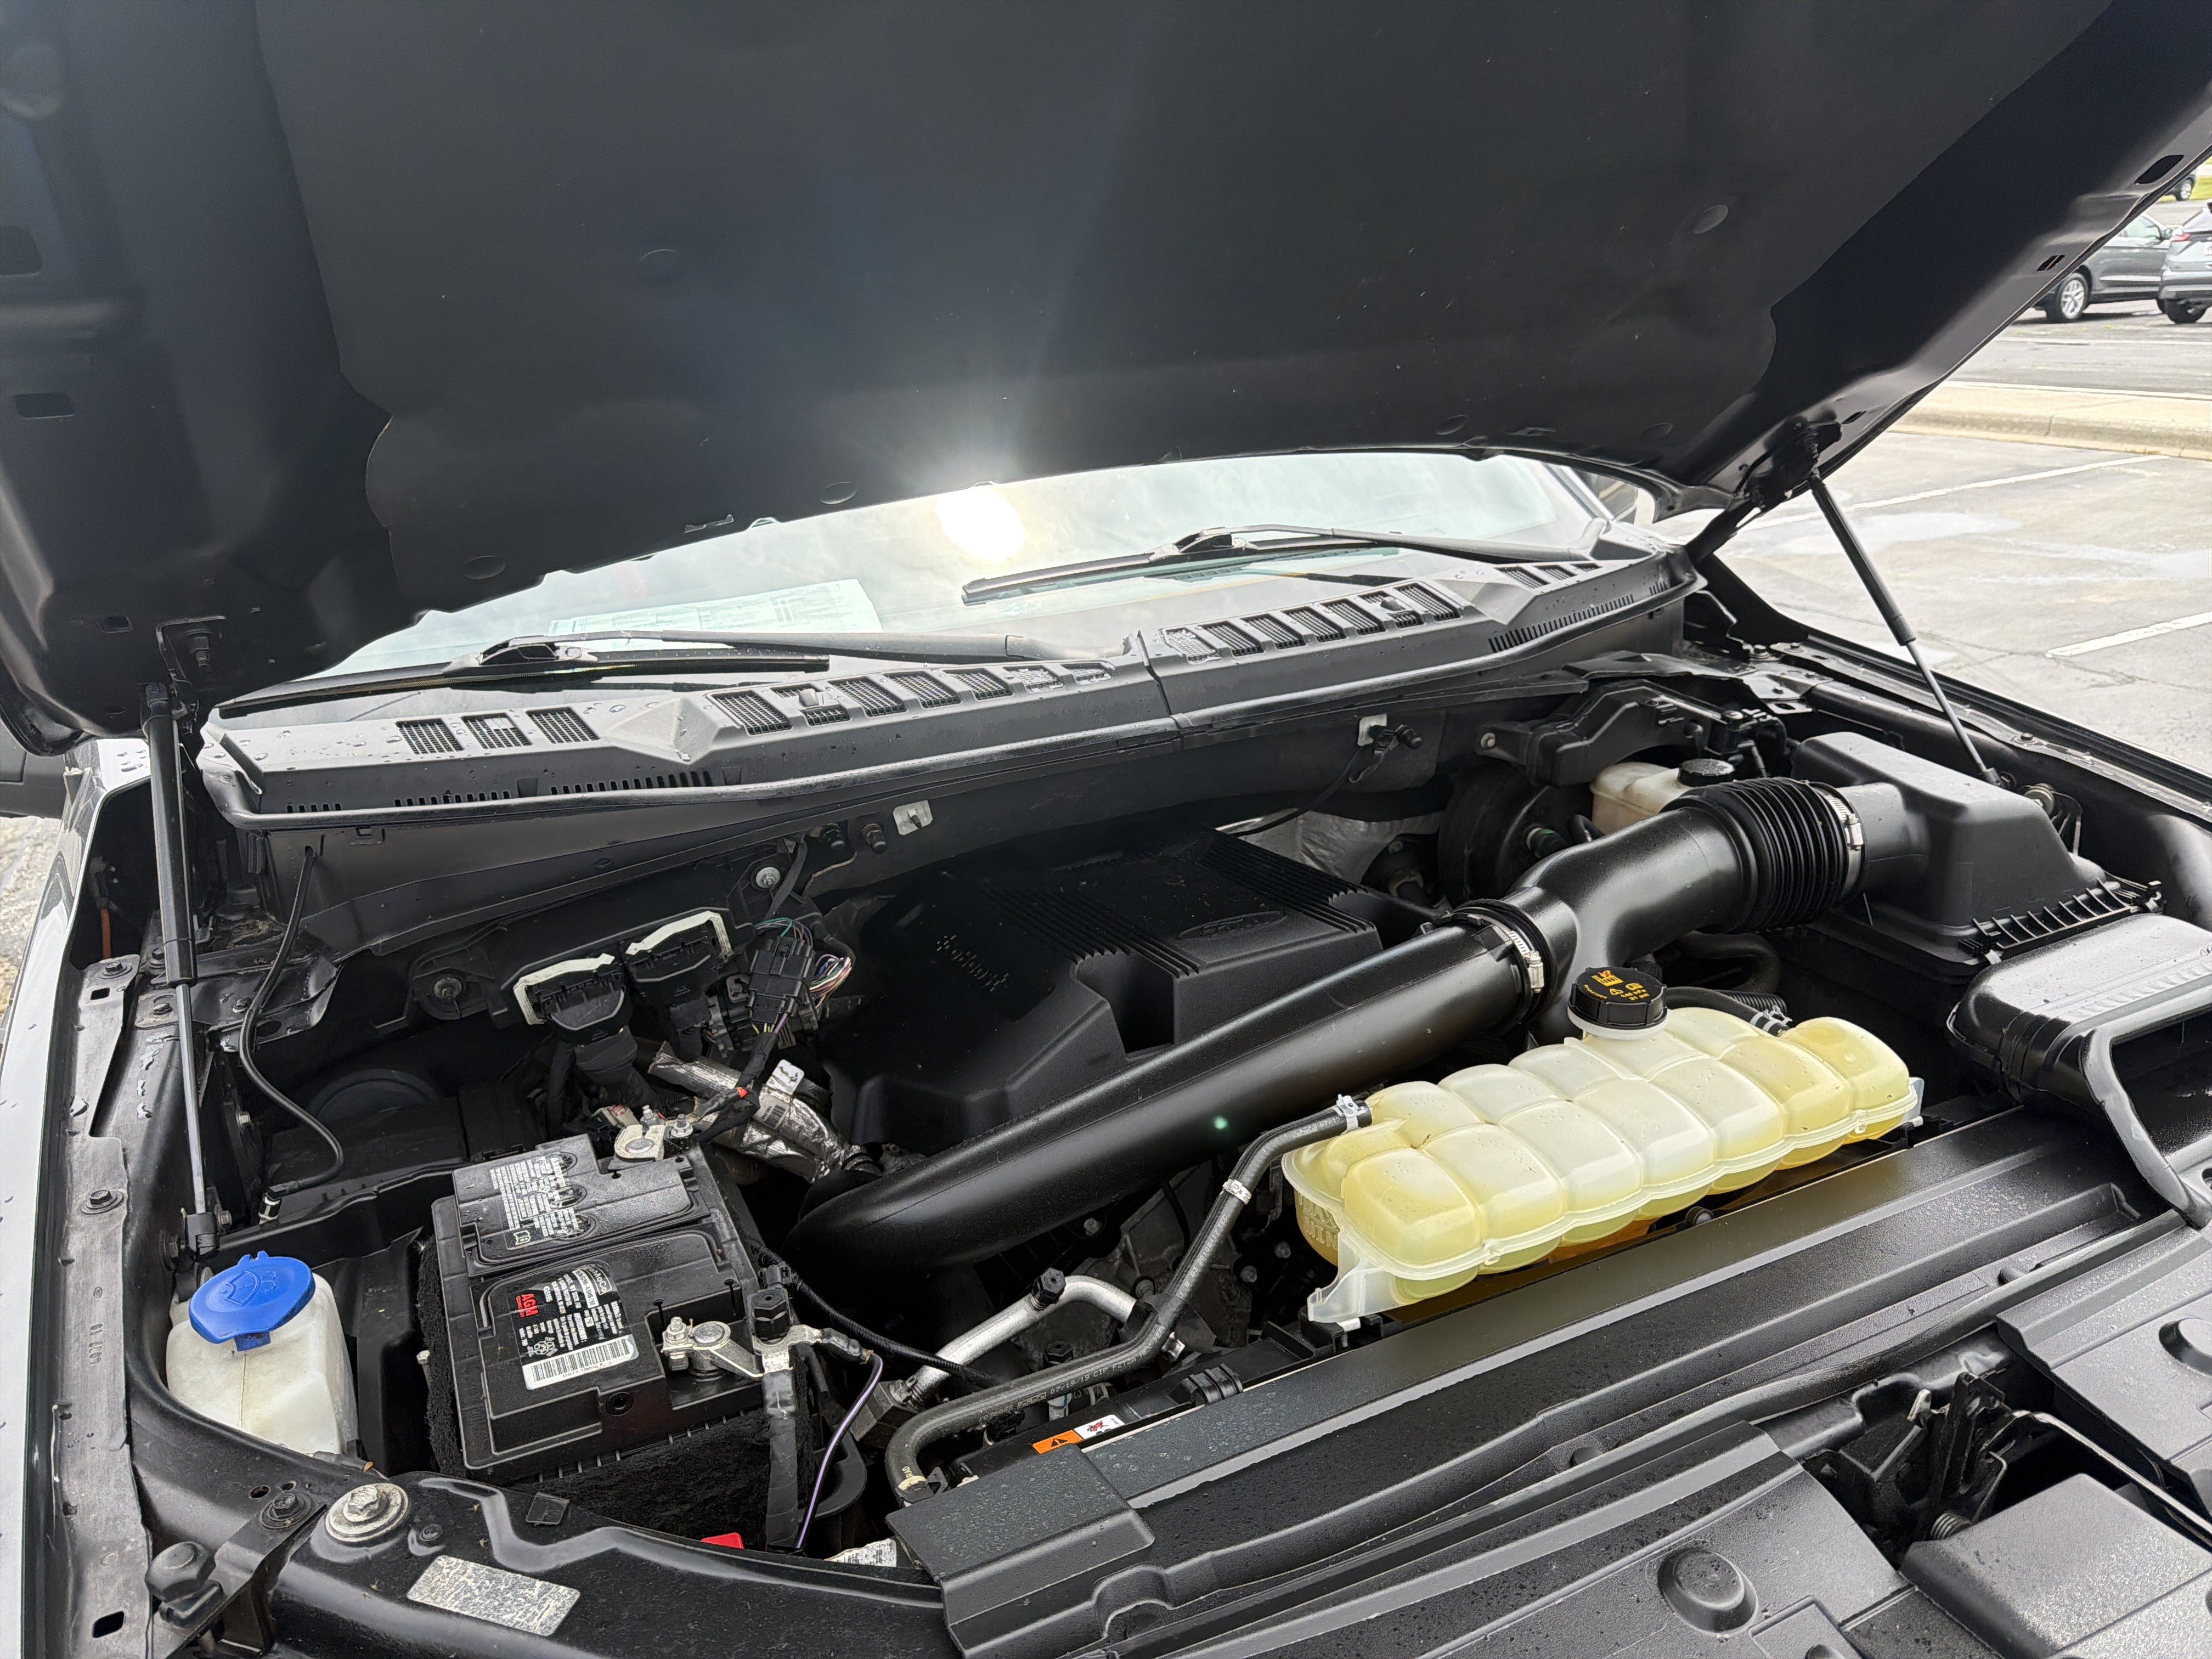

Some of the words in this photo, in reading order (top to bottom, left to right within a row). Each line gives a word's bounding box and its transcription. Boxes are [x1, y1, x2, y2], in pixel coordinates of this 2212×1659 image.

[1305, 1217, 1338, 1251] MIN
[521, 1294, 539, 1316] AGM
[1051, 1374, 1090, 1394] 07/19/19
